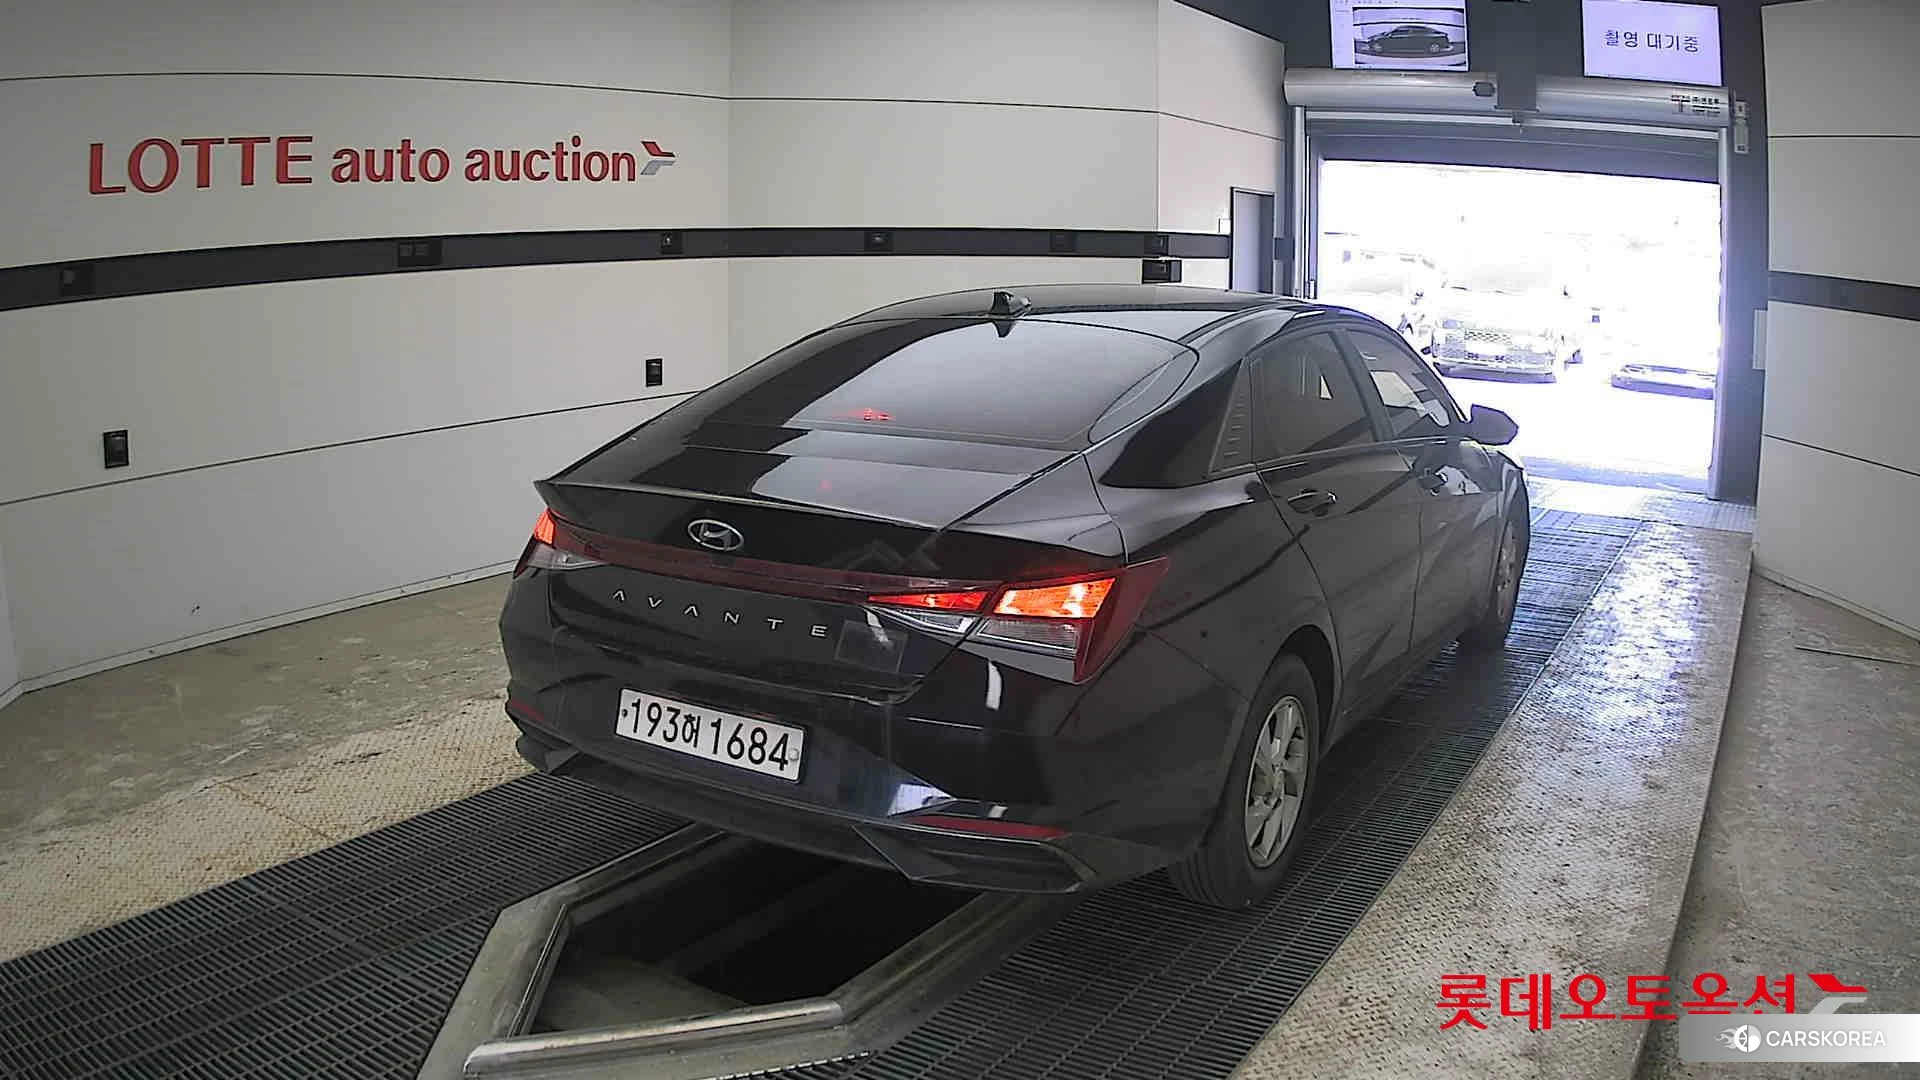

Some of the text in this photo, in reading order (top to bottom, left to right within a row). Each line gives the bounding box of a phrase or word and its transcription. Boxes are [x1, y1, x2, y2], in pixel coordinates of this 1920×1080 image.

[1646, 33, 1699, 52] 대기중
[89, 135, 637, 196] LOTTE auto auction
[612, 589, 828, 638] AVANTE
[710, 717, 790, 771] 1684
